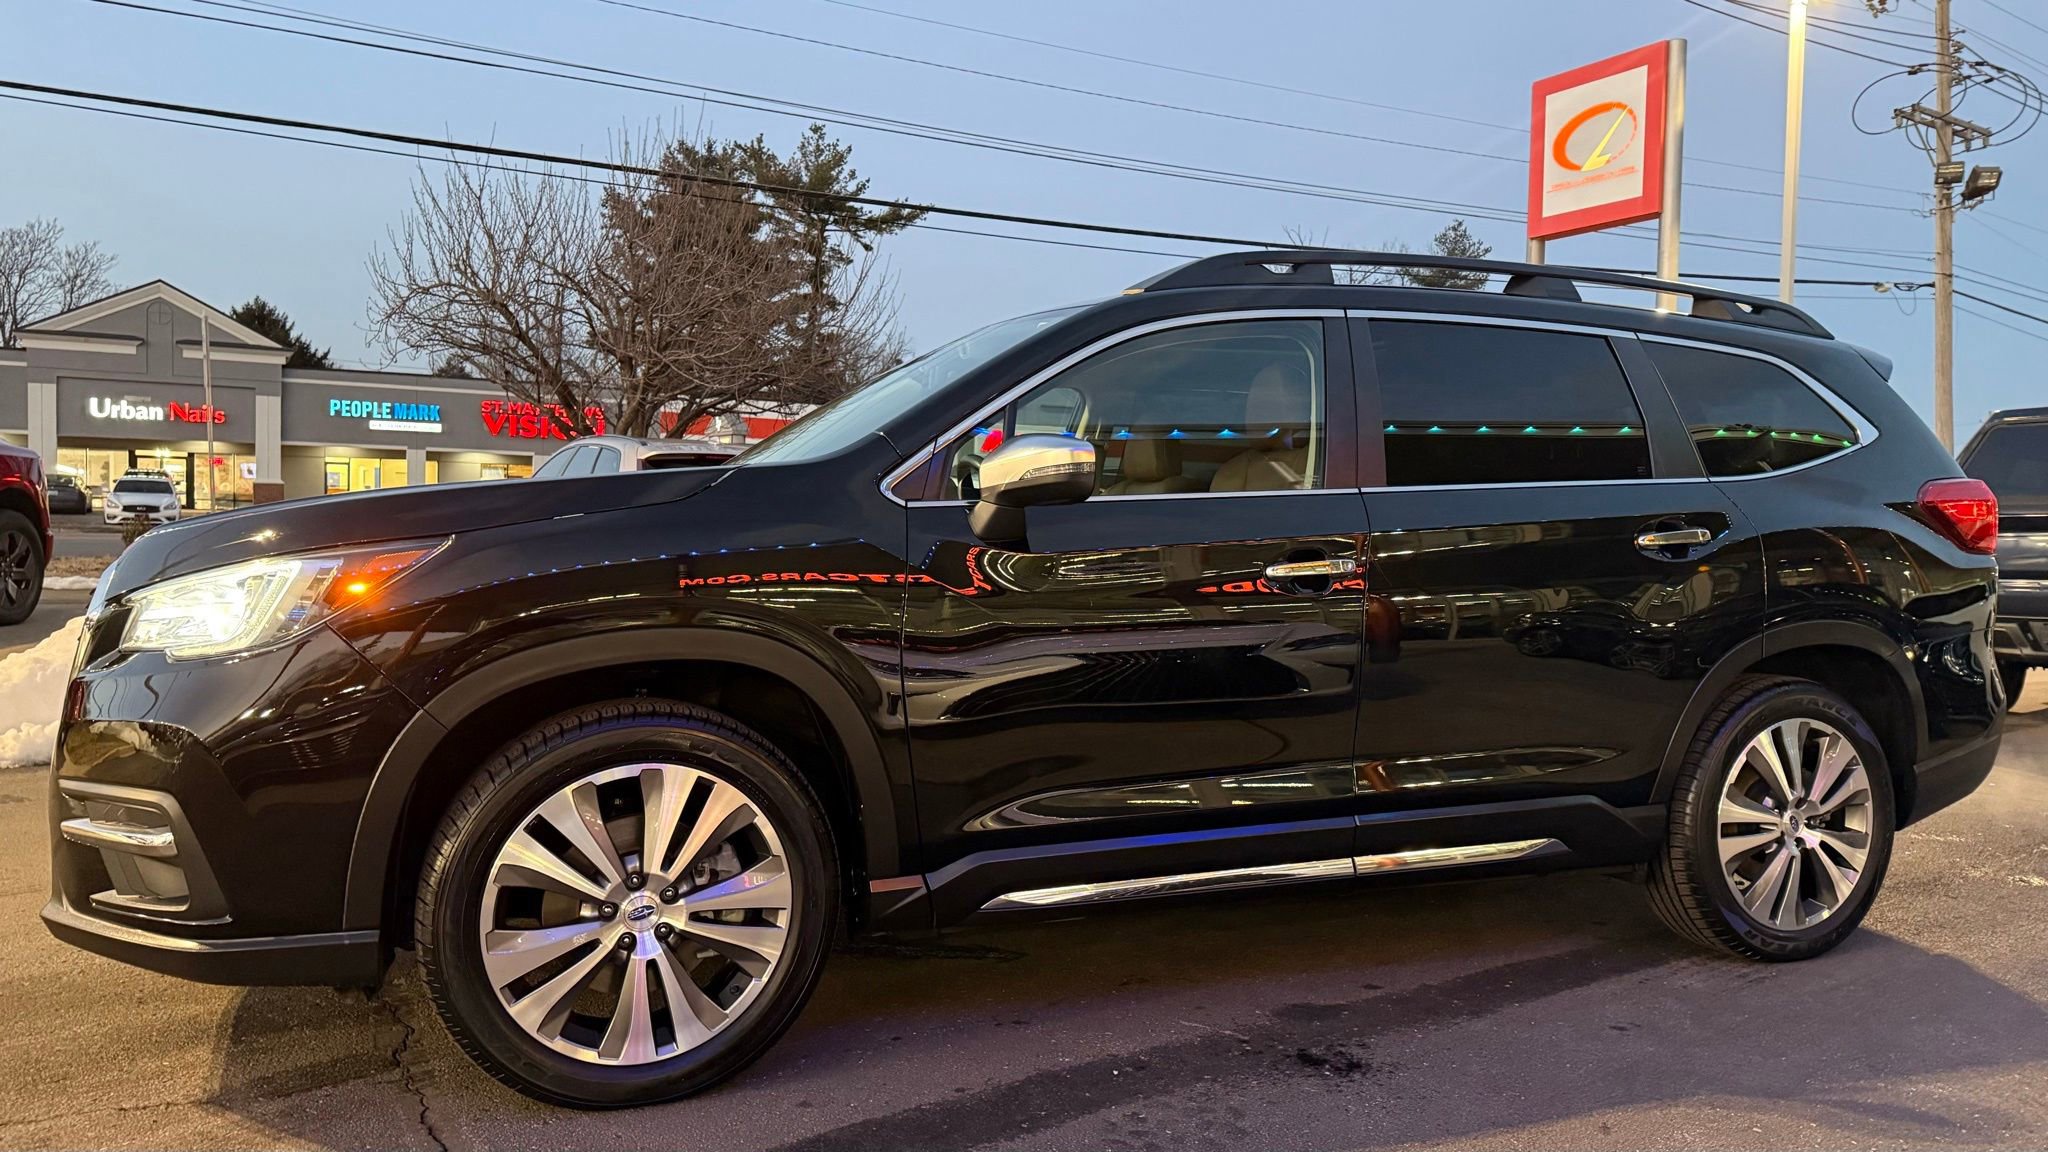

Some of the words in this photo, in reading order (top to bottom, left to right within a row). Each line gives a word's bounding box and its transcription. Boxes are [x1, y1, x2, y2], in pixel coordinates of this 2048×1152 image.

[89, 397, 164, 421] Urban
[169, 401, 226, 424] Nails
[481, 400, 504, 413] ST.
